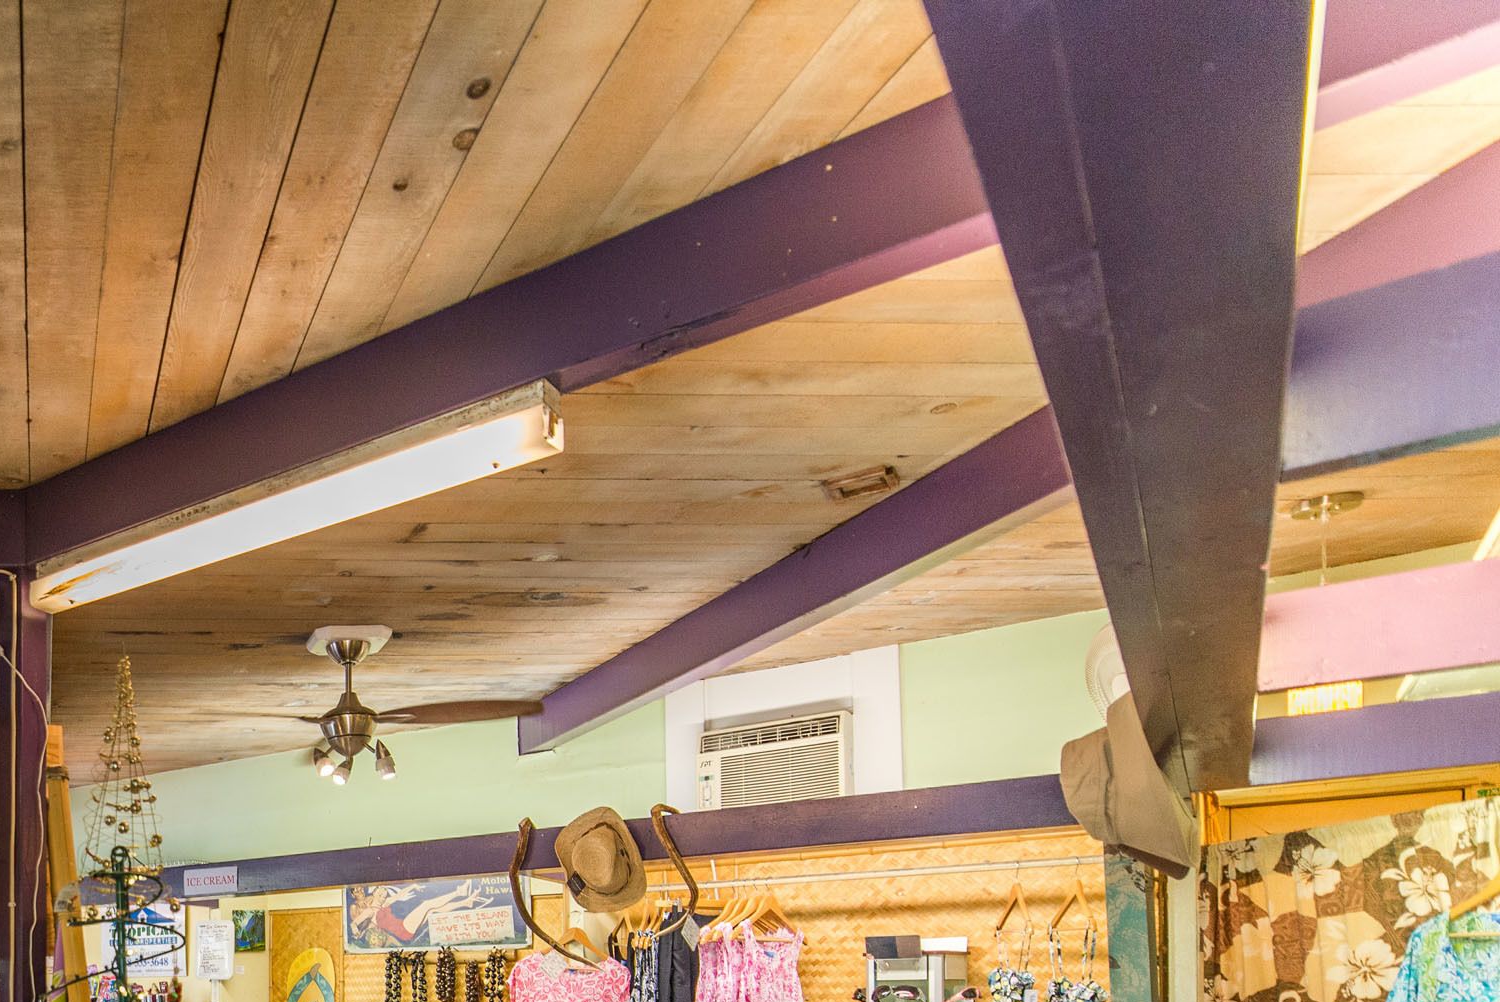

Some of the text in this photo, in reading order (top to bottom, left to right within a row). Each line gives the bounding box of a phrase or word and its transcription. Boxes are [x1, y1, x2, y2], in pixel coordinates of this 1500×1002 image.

[187, 875, 235, 886] ICE CREAM
[485, 886, 512, 894] Haw
[453, 914, 472, 923] THE
[476, 911, 510, 921] ISLAND
[436, 919, 506, 933] HAVE ITS WAY
[109, 926, 177, 938] TOPICA
[445, 931, 472, 941] WITH
